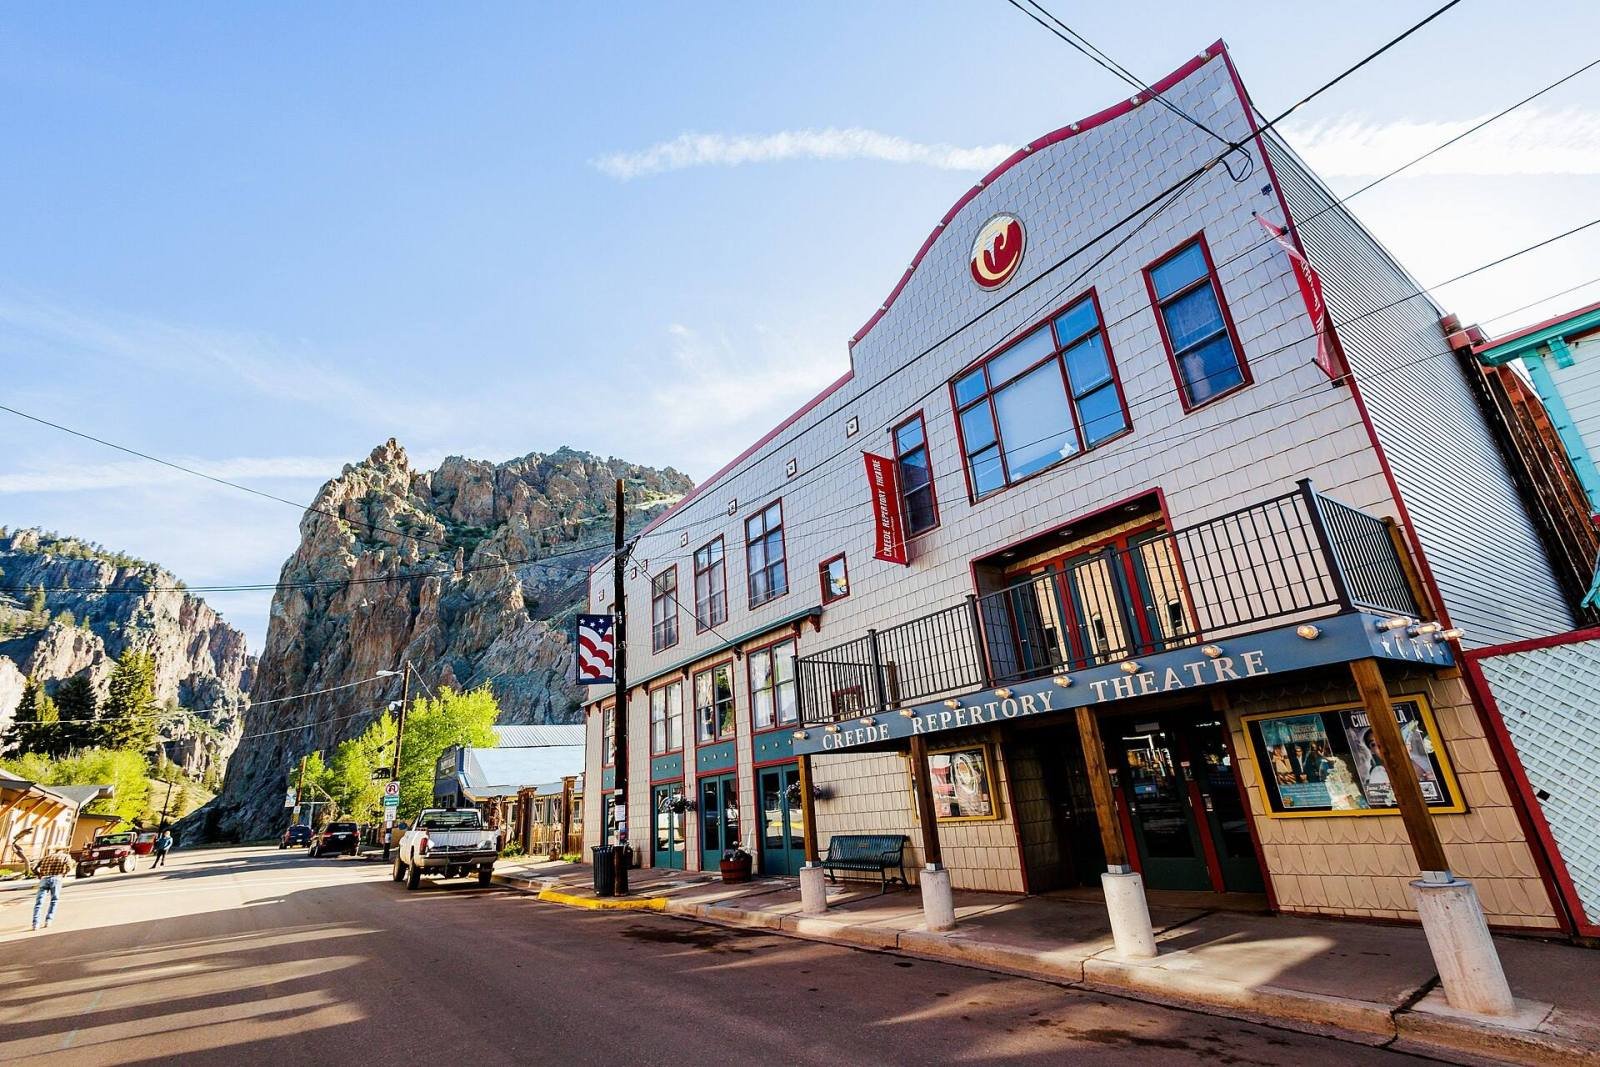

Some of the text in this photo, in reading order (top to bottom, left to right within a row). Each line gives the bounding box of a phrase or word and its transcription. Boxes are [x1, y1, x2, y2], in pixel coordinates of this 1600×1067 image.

[873, 459, 892, 557] CREEDE REPERTORY THEATRE
[822, 650, 1269, 750] CREEDE REPERTORY THEATRE
